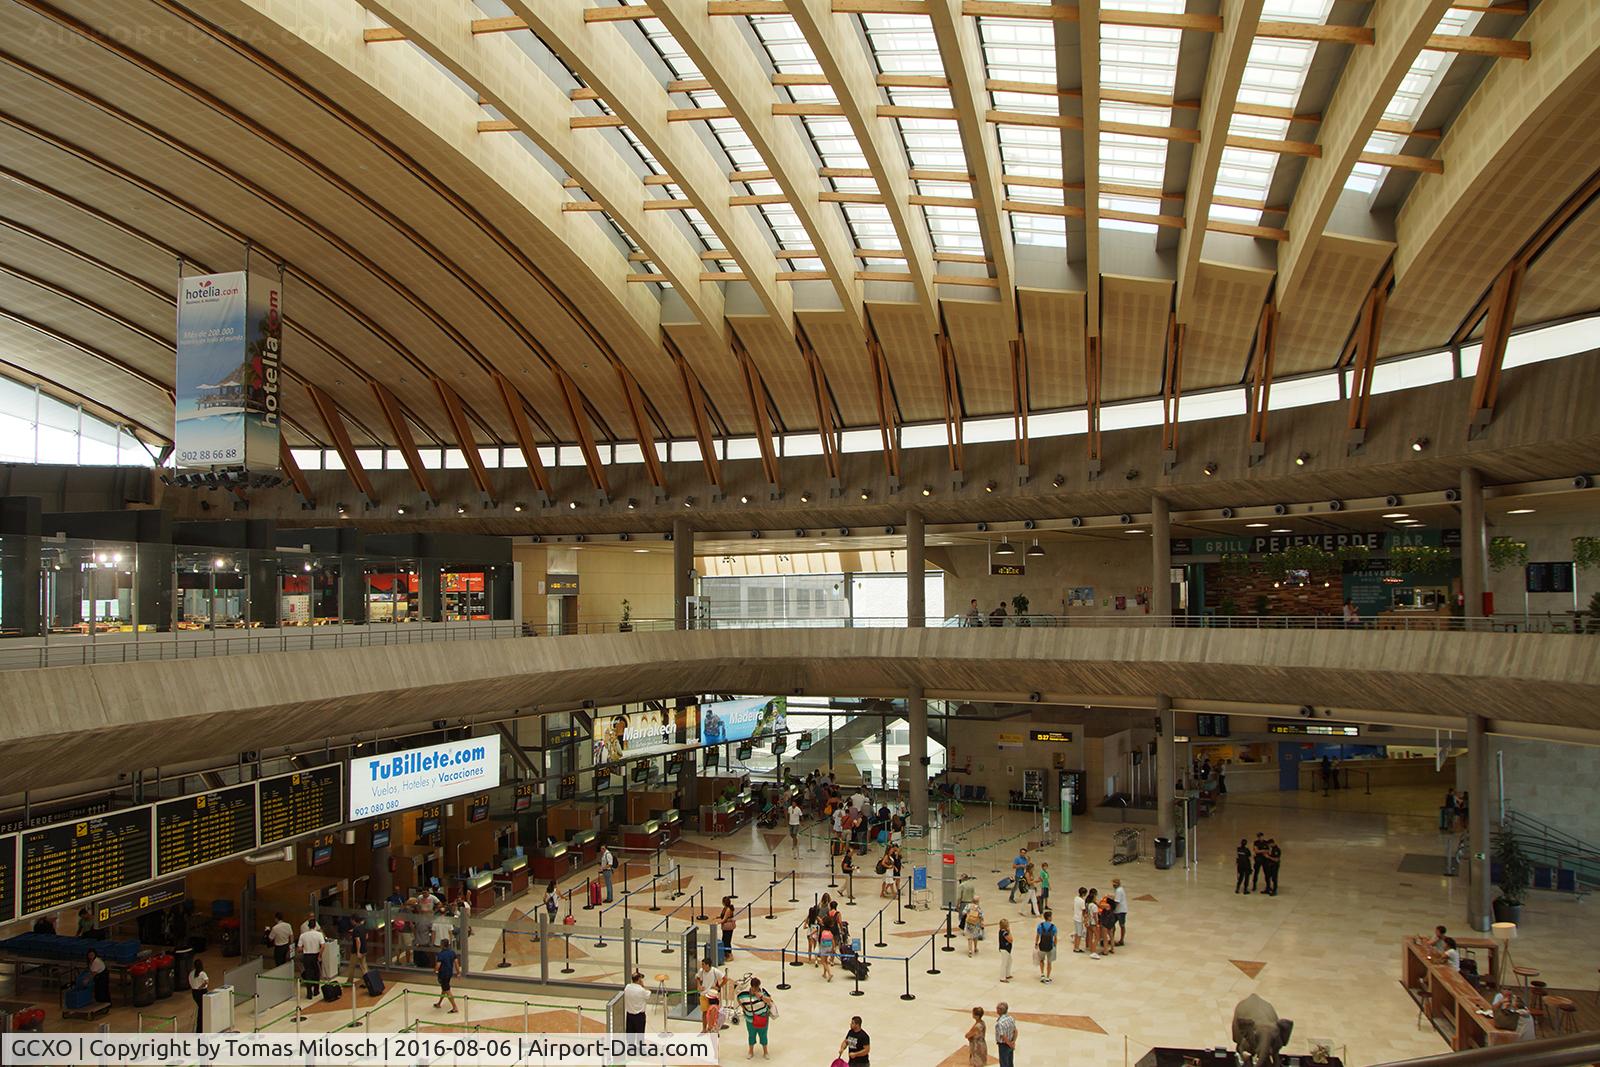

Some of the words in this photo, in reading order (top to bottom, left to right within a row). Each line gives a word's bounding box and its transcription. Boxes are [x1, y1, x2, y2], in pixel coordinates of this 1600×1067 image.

[186, 286, 239, 300] hotelia.com
[181, 450, 198, 461] 902
[201, 450, 211, 460] 88
[213, 449, 224, 460] 66
[226, 449, 238, 459] 88
[1206, 540, 1243, 552] GRILL
[1256, 534, 1379, 552] PEJEVERDE
[1393, 535, 1424, 547] BAR
[729, 710, 764, 725] Madeira
[623, 722, 677, 742] Marrakech
[369, 745, 485, 782] TuBillete.com
[371, 782, 400, 797] Vuelos,
[402, 776, 430, 791] Hoteles
[431, 778, 437, 788] y
[438, 766, 484, 783] Vacaciones
[355, 806, 369, 817] 902
[371, 802, 385, 813] 080
[386, 799, 399, 810] 080
[480, 795, 489, 806] 17
[430, 807, 440, 818] 16
[1, 815, 53, 833] PEJEERDE
[381, 819, 390, 830] 15
